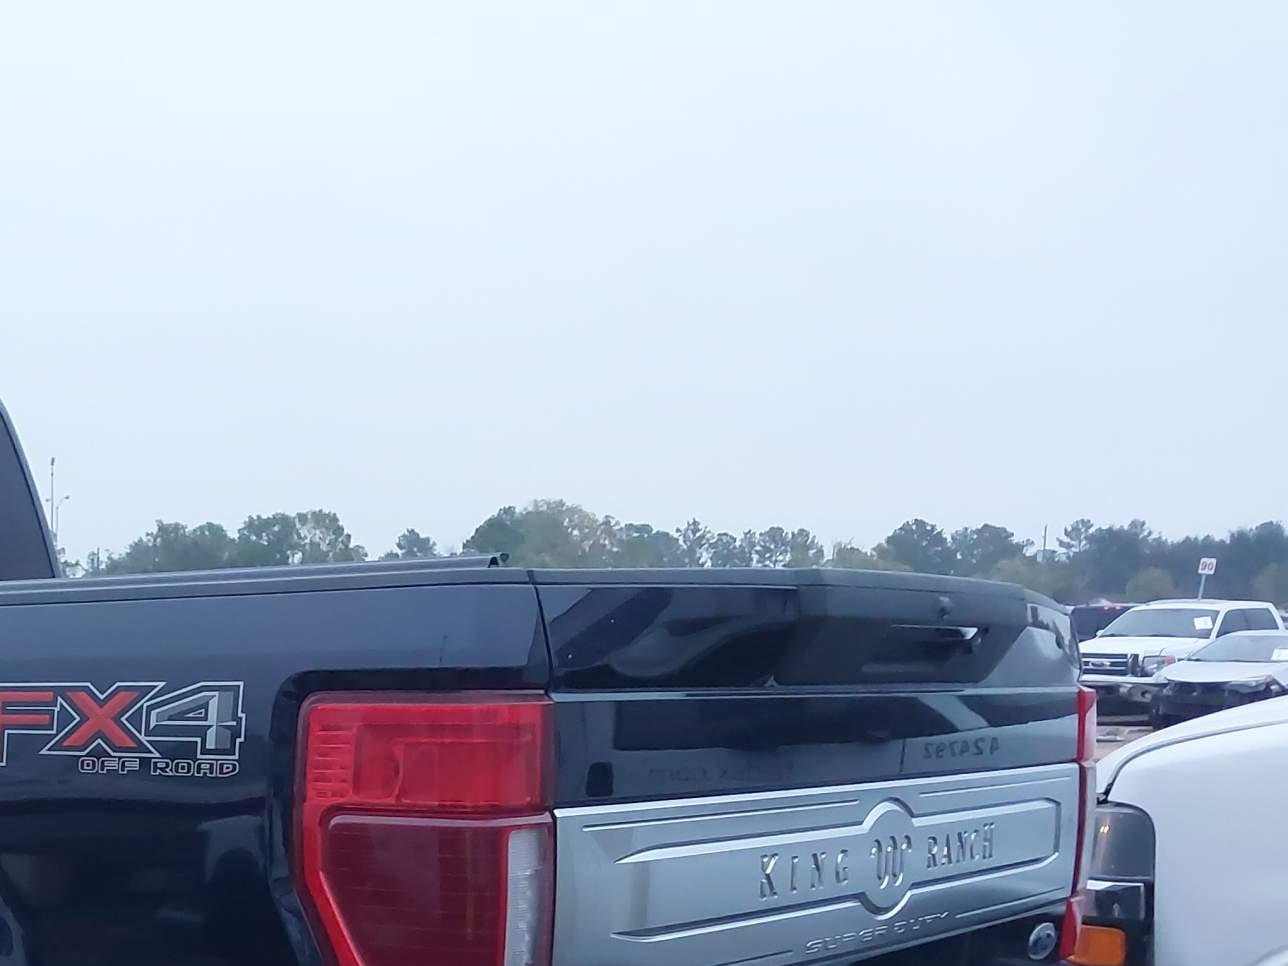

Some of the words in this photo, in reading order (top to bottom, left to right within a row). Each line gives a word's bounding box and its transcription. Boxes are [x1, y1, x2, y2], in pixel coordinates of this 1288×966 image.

[78, 757, 140, 775] OFF
[150, 759, 240, 777] ROAD
[759, 849, 849, 900] KING
[926, 822, 996, 869] RANCH
[804, 925, 889, 954] SUPER
